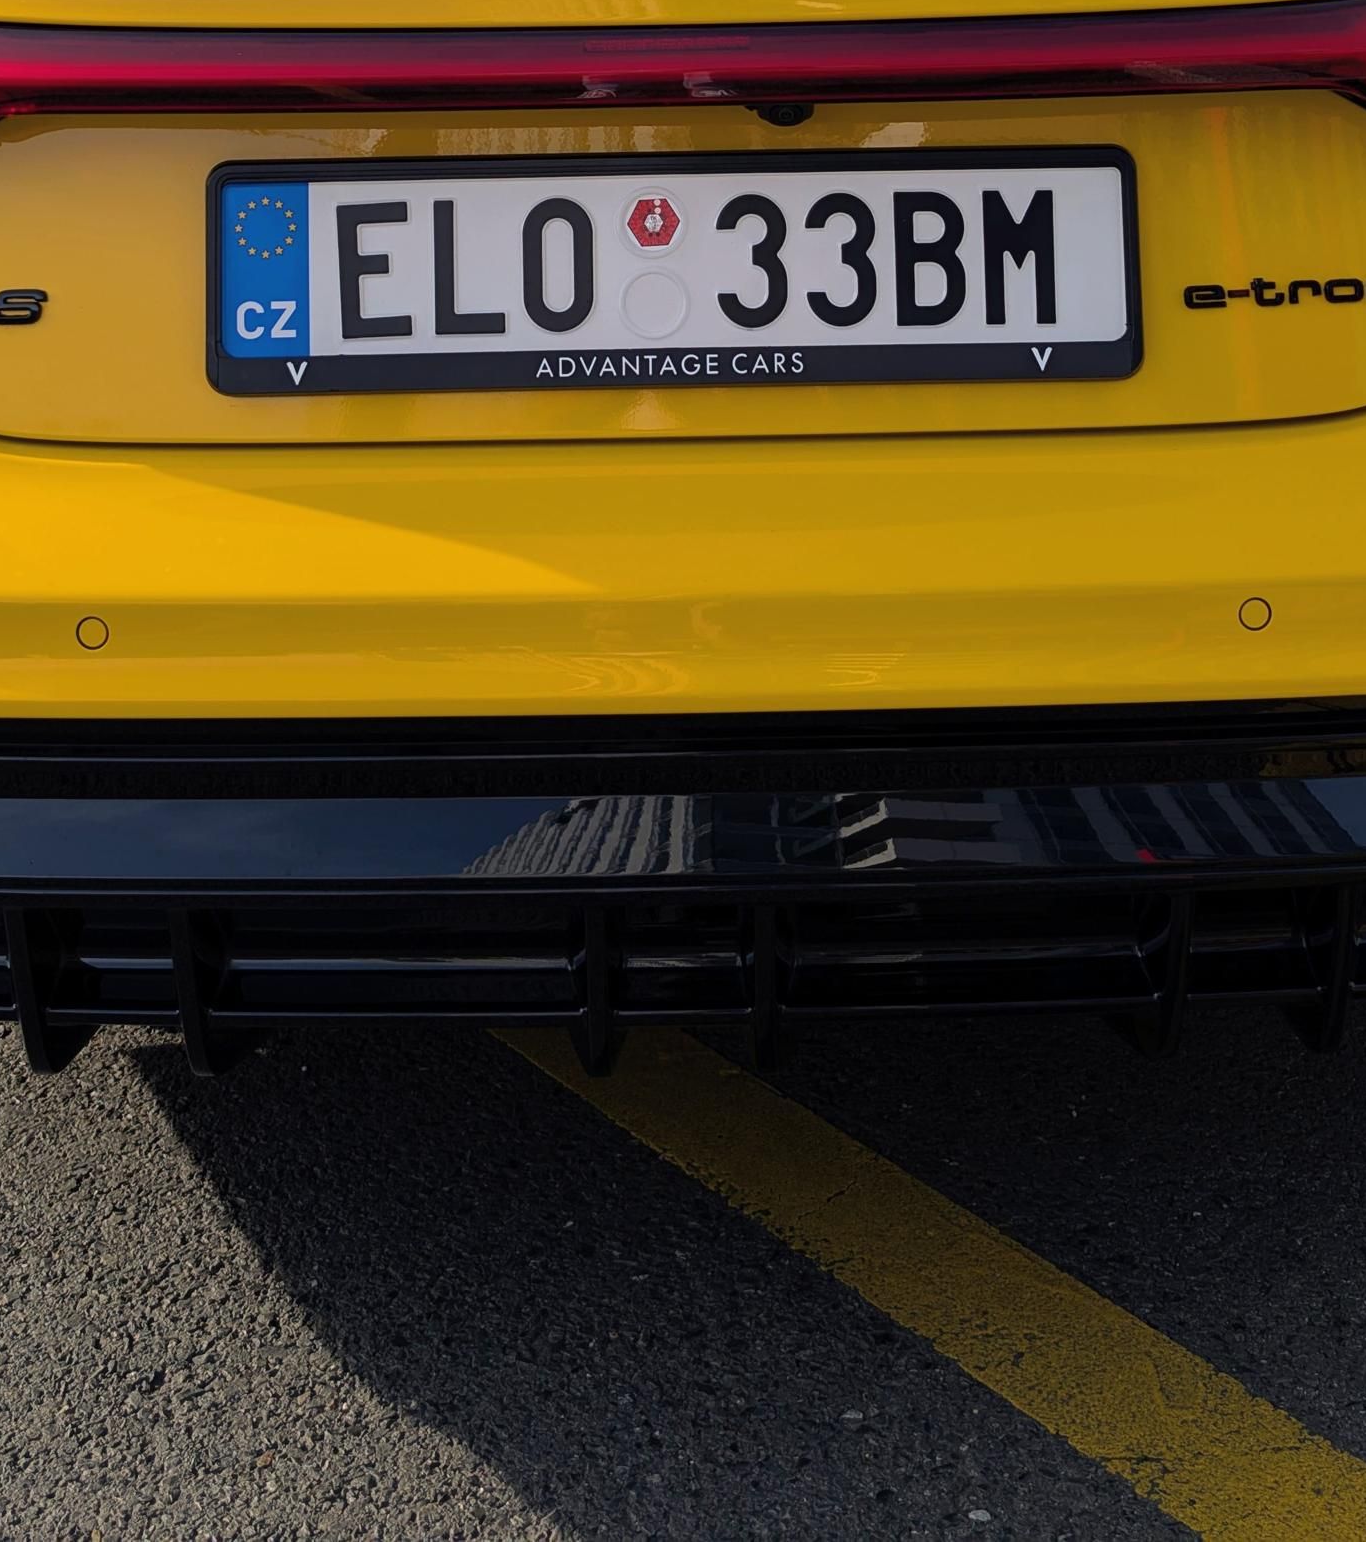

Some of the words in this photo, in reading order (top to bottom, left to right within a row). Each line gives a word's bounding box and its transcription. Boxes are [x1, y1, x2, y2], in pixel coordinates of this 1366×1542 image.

[715, 190, 1055, 328] 33BM
[236, 300, 297, 340] CZ
[536, 354, 719, 378] ADVANTAGE
[732, 352, 804, 374] CARS
